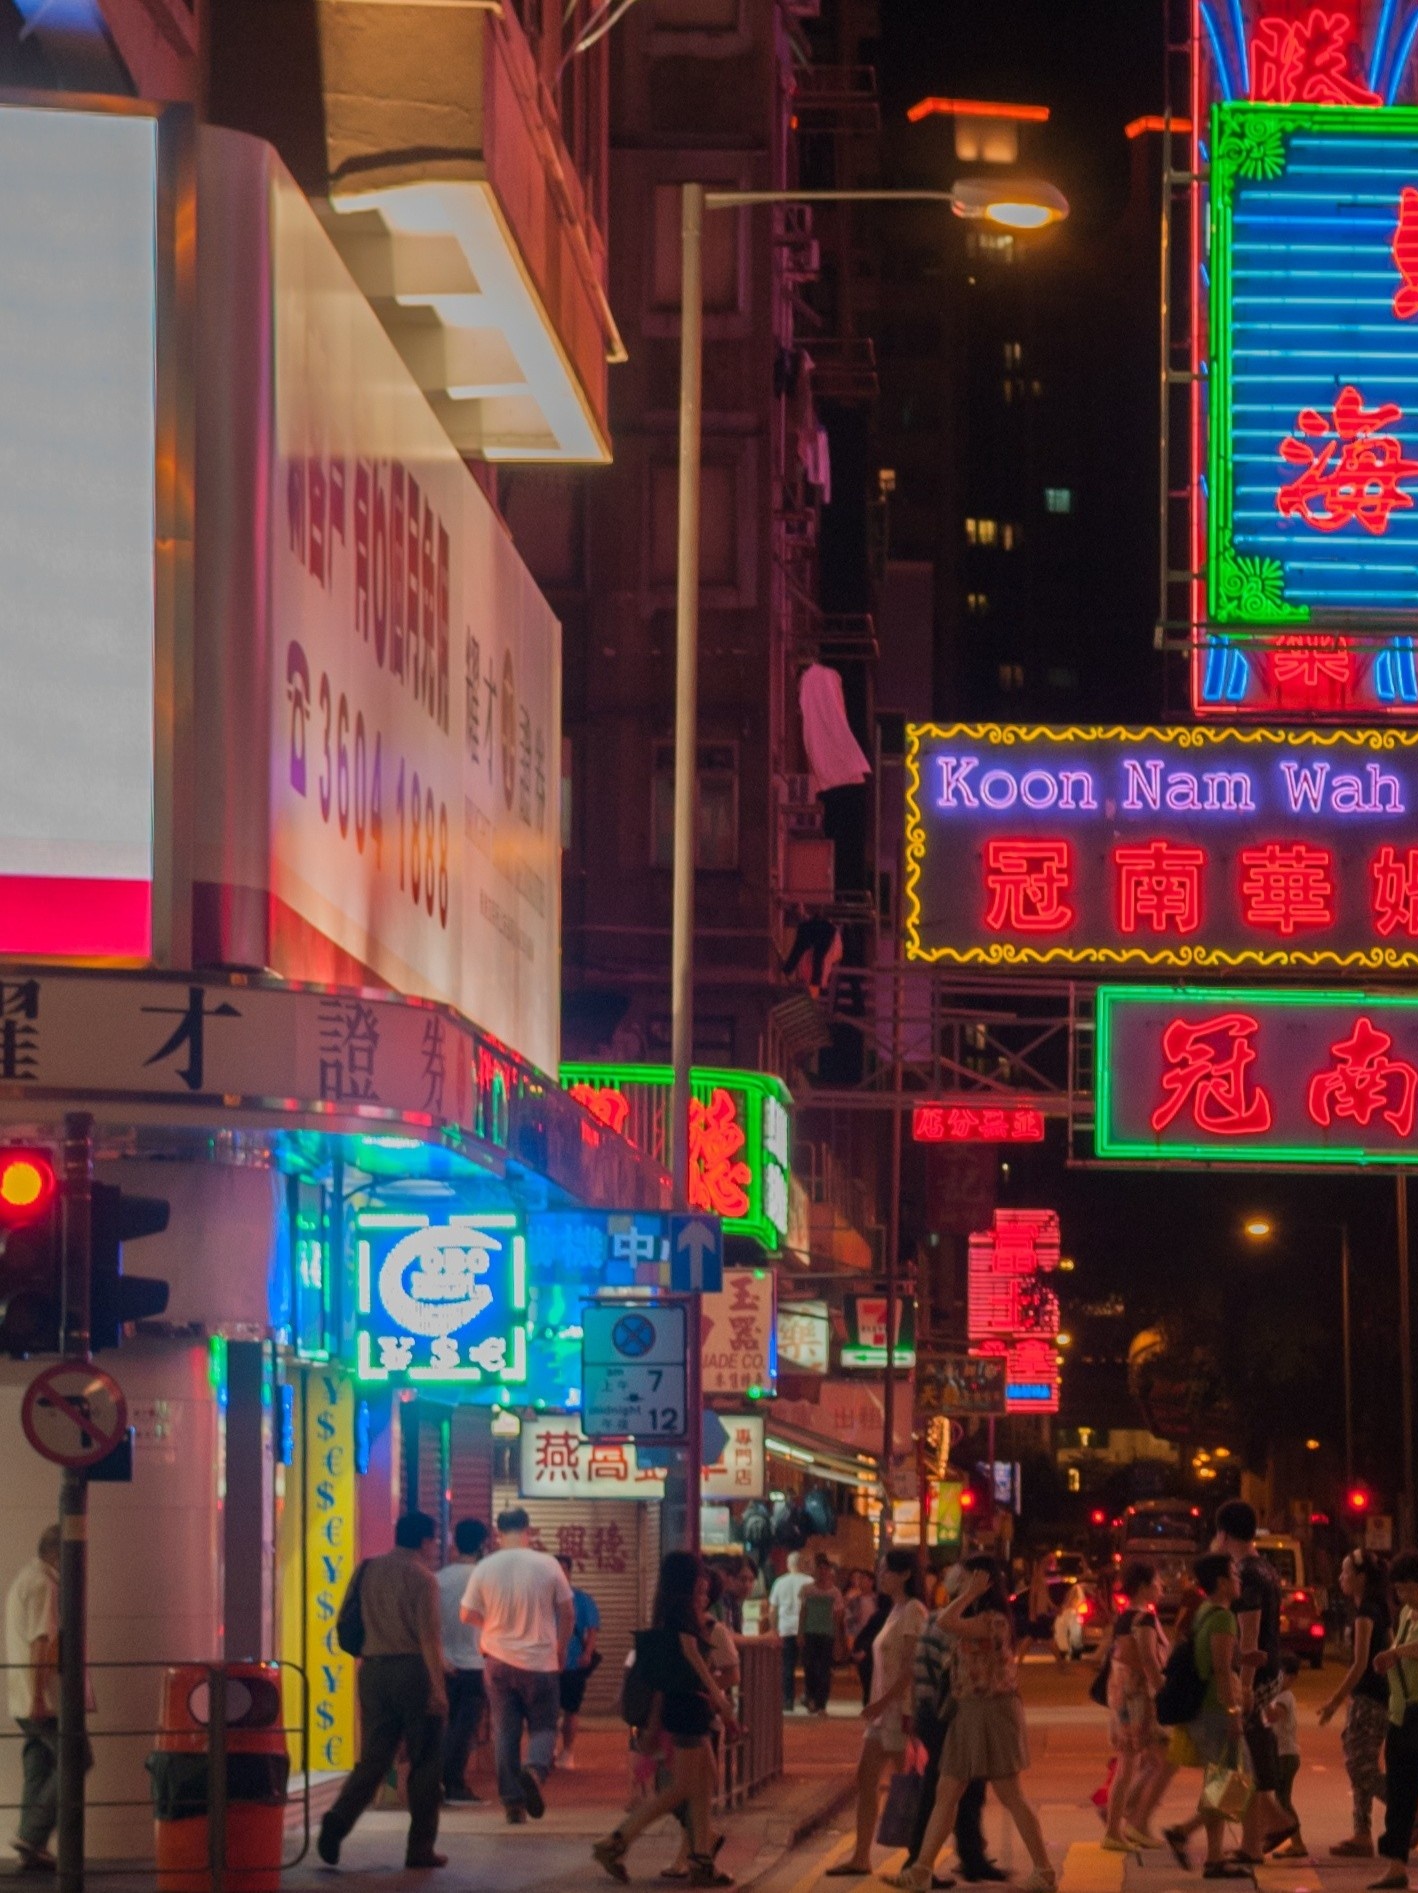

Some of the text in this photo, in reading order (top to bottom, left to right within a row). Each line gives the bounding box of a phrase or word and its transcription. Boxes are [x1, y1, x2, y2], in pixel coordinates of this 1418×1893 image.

[319, 671, 450, 930] 3604 1888
[937, 756, 1097, 809] Koon
[1123, 758, 1256, 813] Nam
[1280, 761, 1406, 815] Wah
[648, 1370, 663, 1392] 7
[649, 1407, 678, 1430] 12
